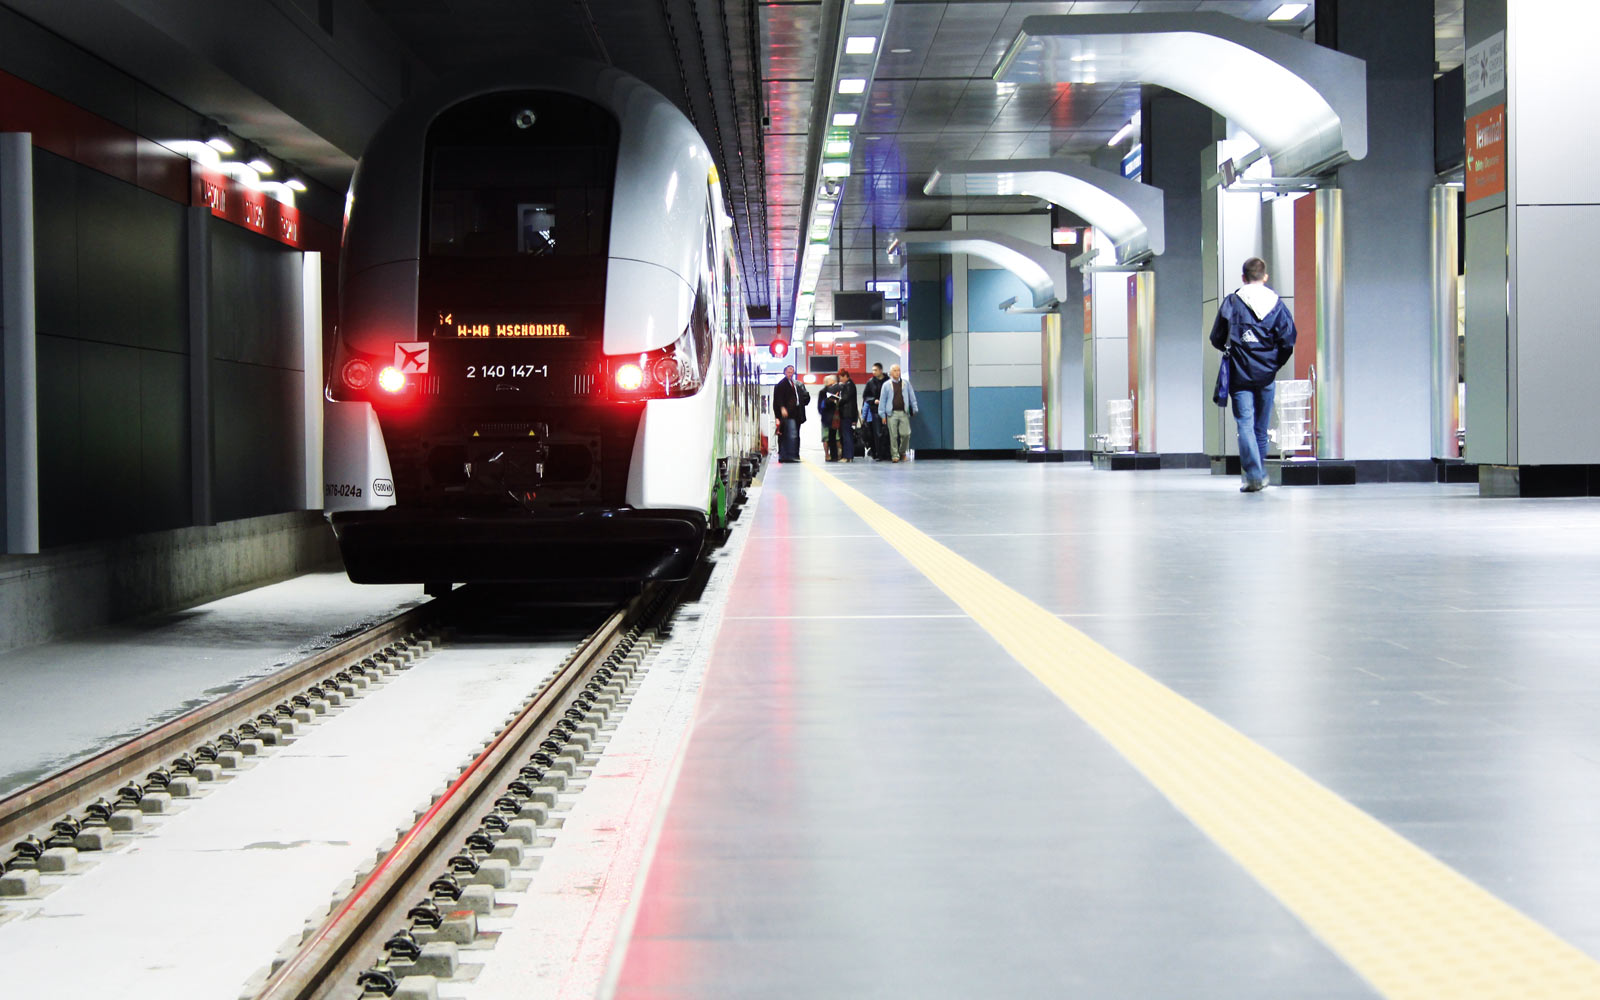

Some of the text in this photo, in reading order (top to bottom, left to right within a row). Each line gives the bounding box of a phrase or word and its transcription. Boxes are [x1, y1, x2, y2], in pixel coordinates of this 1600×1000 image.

[457, 324, 490, 336] W-WA
[466, 365, 548, 378] 2 140 147-1
